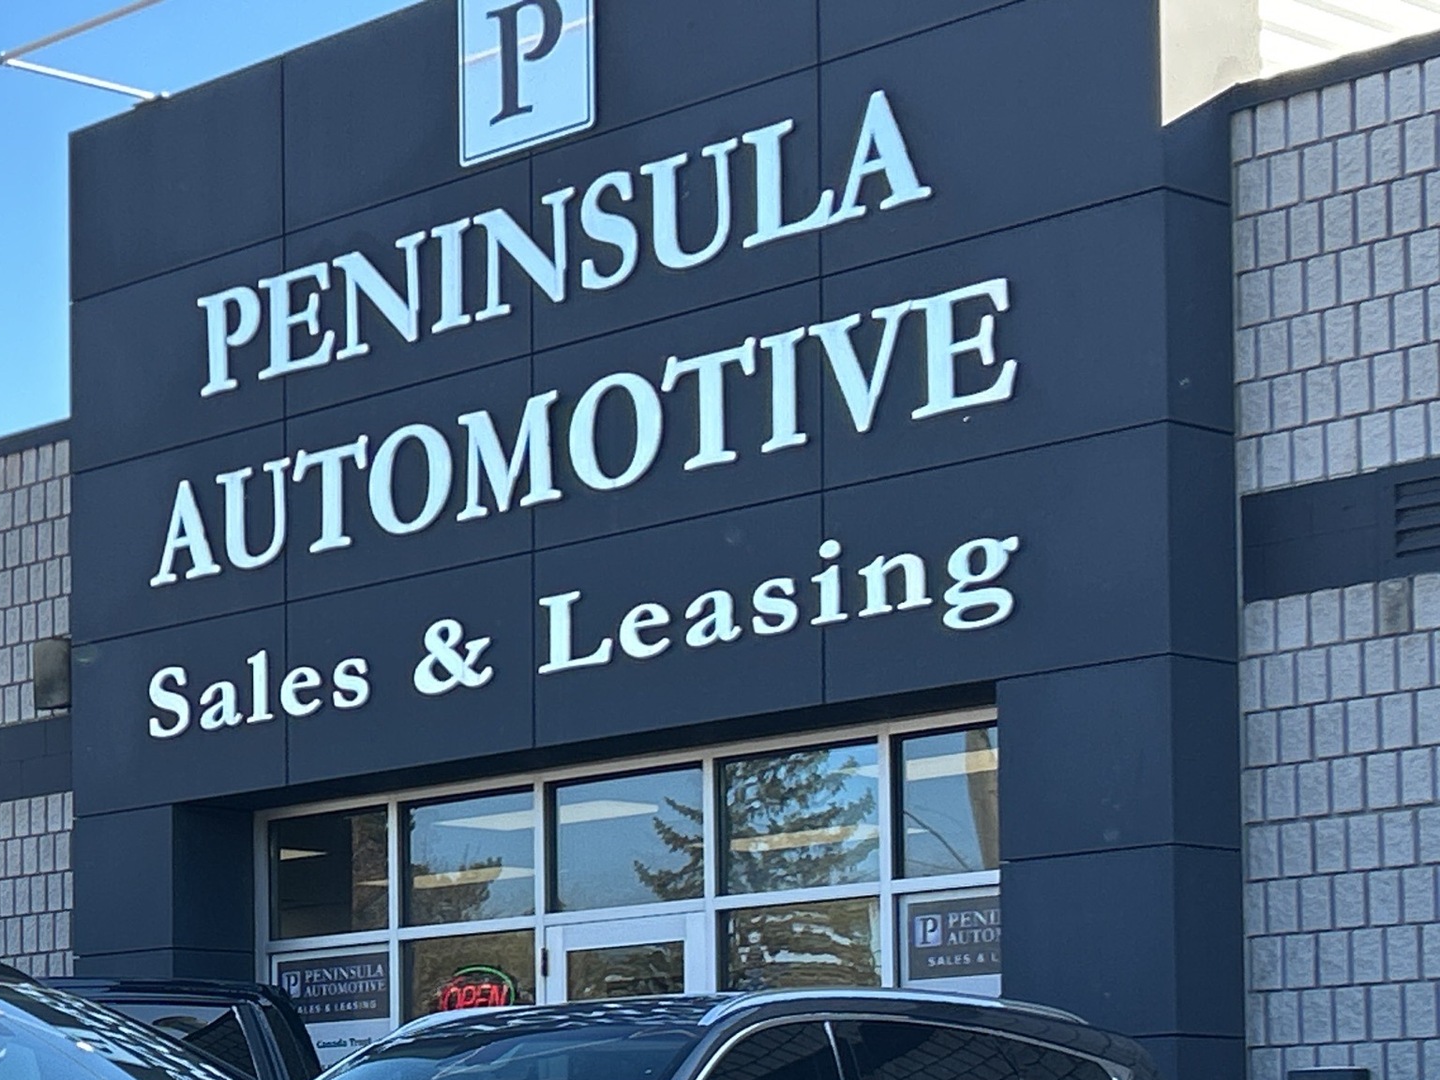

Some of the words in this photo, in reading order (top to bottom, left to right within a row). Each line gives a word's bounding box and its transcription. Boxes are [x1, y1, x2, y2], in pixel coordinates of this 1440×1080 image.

[485, 0, 564, 127] P
[197, 89, 932, 398] PENINSULA
[149, 277, 1018, 588] AUTOMOTIVE
[147, 650, 370, 739] Sales
[412, 618, 493, 696] &
[537, 535, 1019, 675] Leasing
[948, 908, 1001, 929] PENI
[927, 953, 971, 967] SALES
[304, 963, 384, 984] PENINSULA
[303, 980, 387, 998] AUTOMOTIVE
[442, 983, 509, 1011] OPEN
[297, 1001, 320, 1014] ALES
[333, 999, 377, 1012] LEASING
